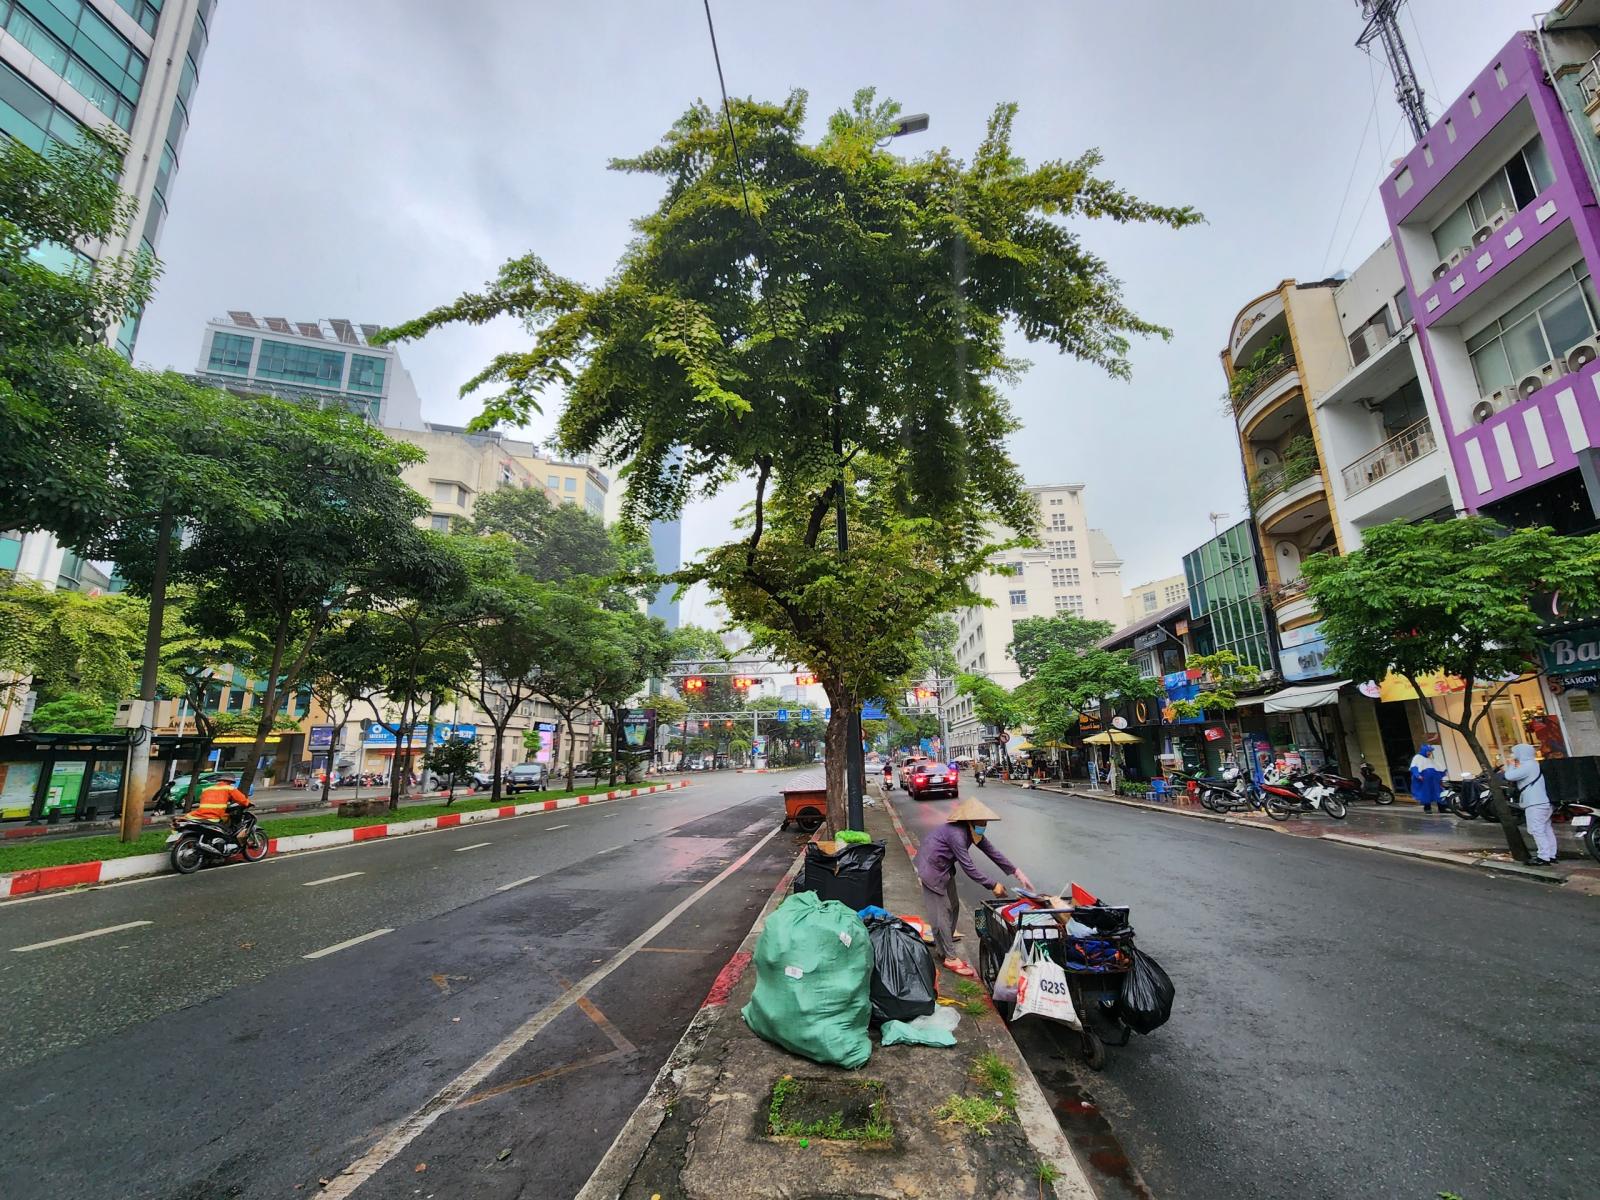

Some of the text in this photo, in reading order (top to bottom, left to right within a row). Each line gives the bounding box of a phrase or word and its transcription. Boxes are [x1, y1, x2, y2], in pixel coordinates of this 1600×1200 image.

[1550, 639, 1600, 666] Ba
[1564, 674, 1597, 686] SAIGON
[1040, 979, 1066, 996] G23S
